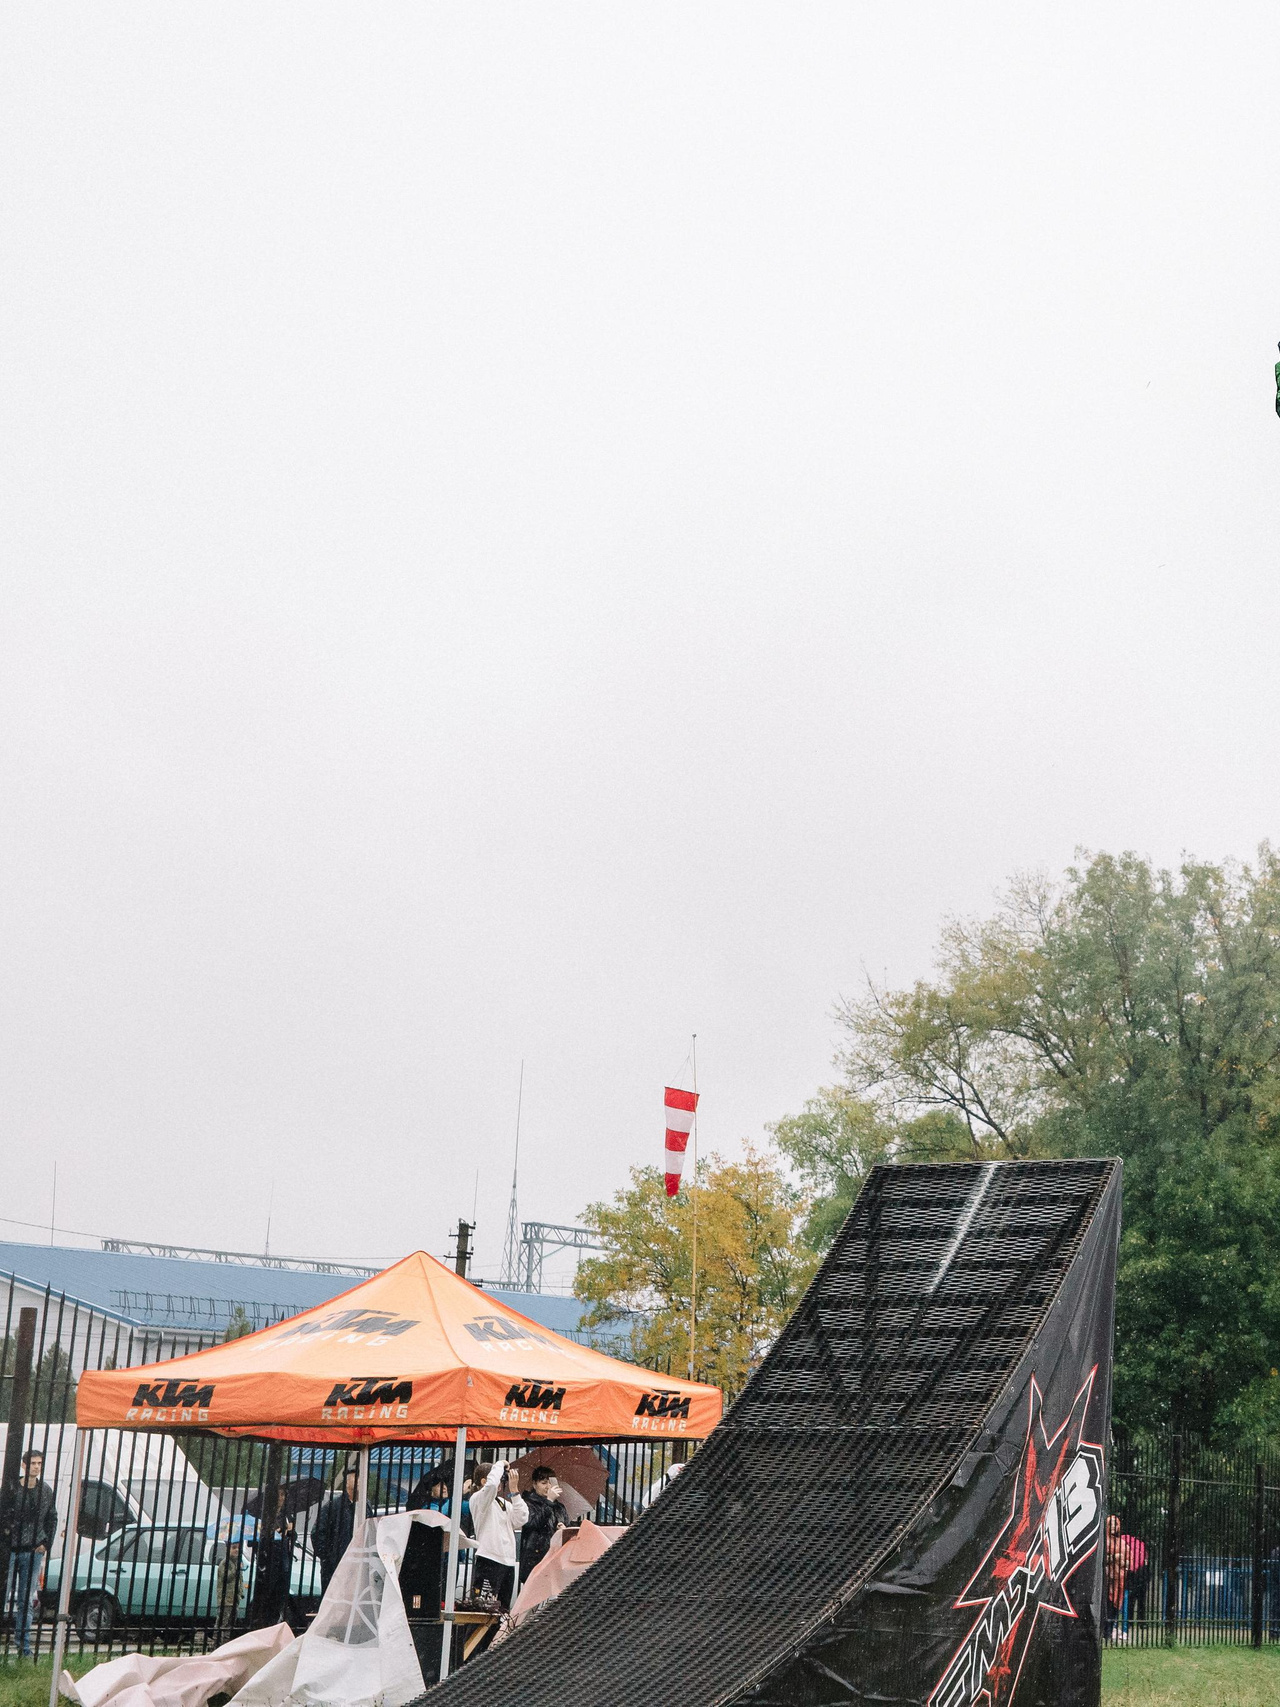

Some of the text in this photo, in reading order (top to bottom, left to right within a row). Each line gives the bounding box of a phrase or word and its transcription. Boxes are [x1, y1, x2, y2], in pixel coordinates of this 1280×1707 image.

[132, 1378, 216, 1407] KTM
[323, 1377, 413, 1406] KTM
[504, 1378, 567, 1410] KTM
[634, 1388, 692, 1418] KTM
